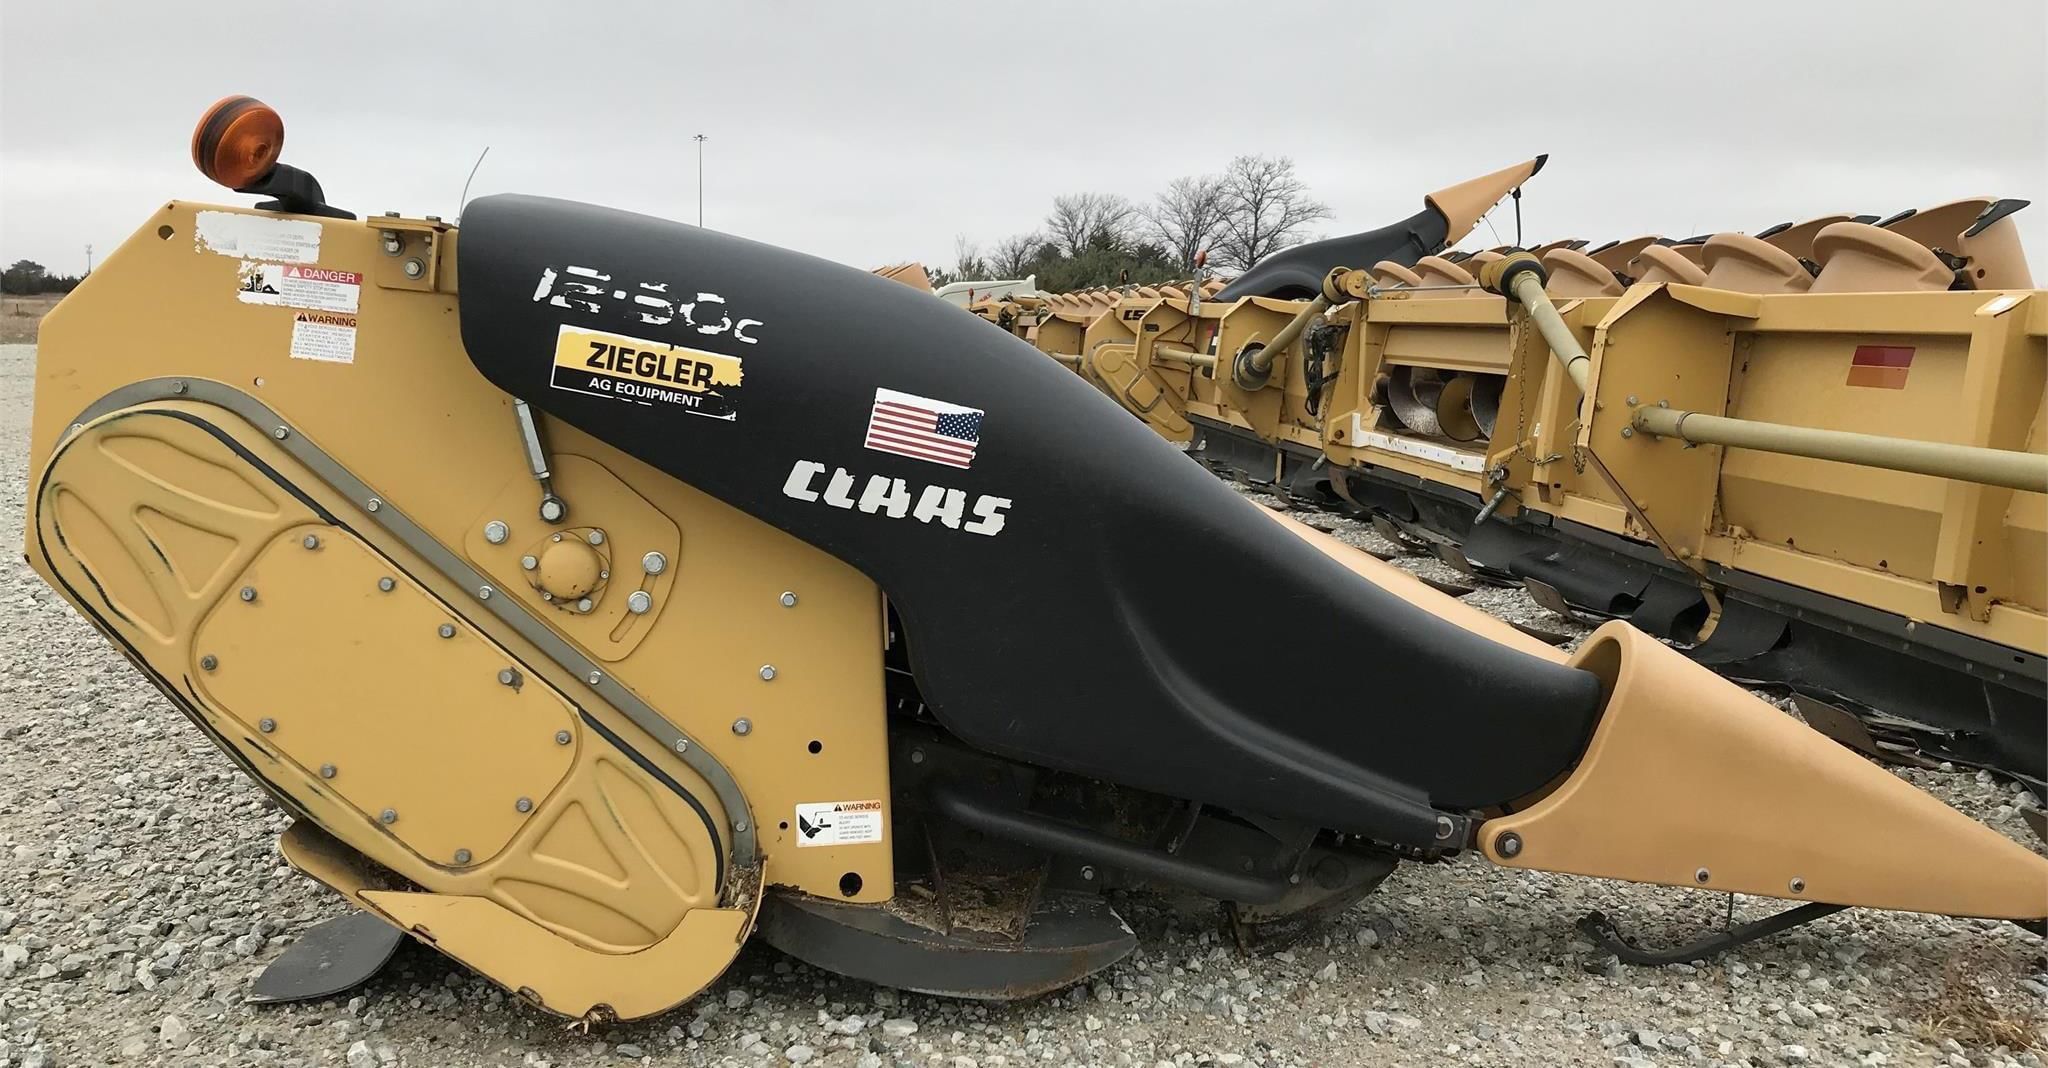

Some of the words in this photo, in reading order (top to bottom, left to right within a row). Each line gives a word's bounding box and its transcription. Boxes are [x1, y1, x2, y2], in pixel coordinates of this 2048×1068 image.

[303, 268, 355, 283] DANGER
[308, 313, 357, 327] WARNING
[586, 341, 713, 389] ZIEGLER
[588, 377, 611, 391] AG
[615, 381, 703, 409] EQUIPMENT
[782, 459, 1012, 537] CLAAS
[843, 802, 881, 812] WARNING
